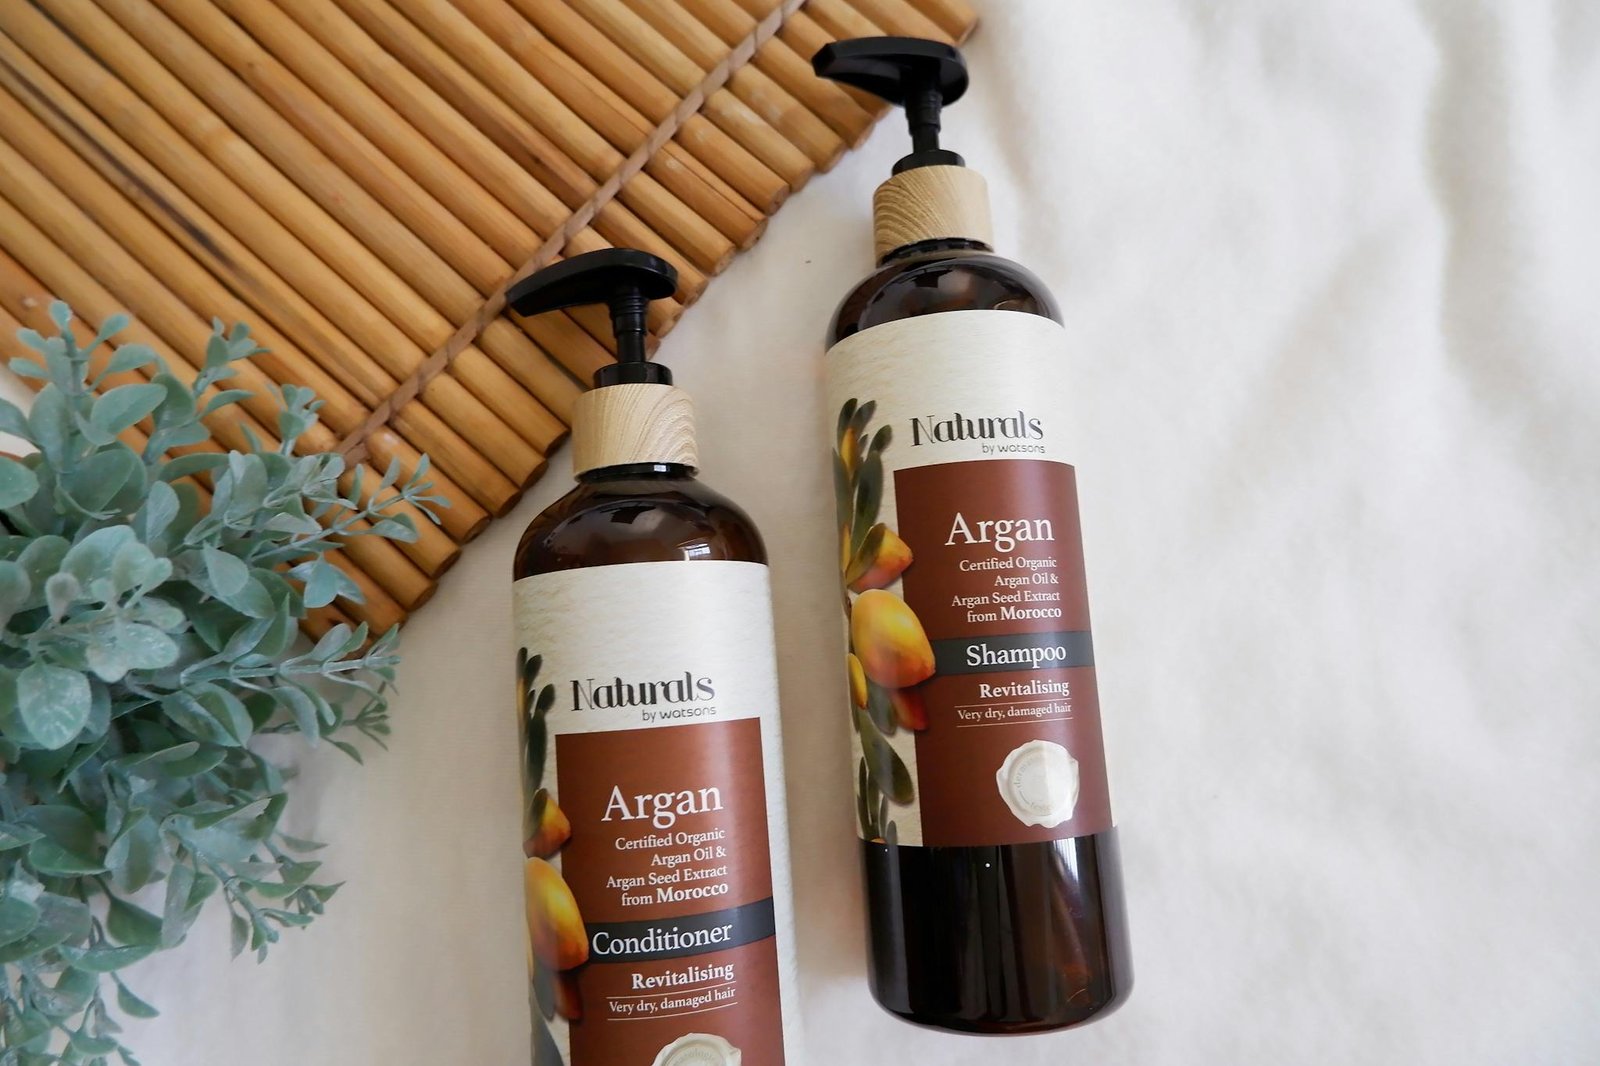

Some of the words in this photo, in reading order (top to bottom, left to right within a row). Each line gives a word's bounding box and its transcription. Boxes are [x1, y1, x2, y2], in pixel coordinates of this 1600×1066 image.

[910, 410, 1044, 446] Naturals
[982, 444, 995, 455] by
[998, 444, 1045, 454] watsons
[944, 512, 1055, 553] Argan
[960, 557, 1013, 571] Certified
[1016, 556, 1056, 570] Organic
[994, 576, 1029, 588] Argan
[1032, 573, 1047, 584] Oil
[1050, 573, 1059, 584] &
[952, 595, 989, 608] Argan
[992, 591, 1021, 603] Seed
[1024, 590, 1060, 602] Extract
[967, 610, 997, 622] from
[1000, 606, 1061, 620] Morocco
[966, 643, 1066, 669] Shampoo
[570, 671, 715, 711] Naturals
[979, 680, 1069, 698] Revitalising
[642, 710, 657, 723] by
[660, 706, 717, 719] watsons
[958, 710, 982, 721] Very
[985, 708, 1005, 720] dry,
[1007, 703, 1052, 717] damaged
[1054, 702, 1071, 713] hair
[601, 785, 724, 829] Argan
[615, 832, 672, 850] Certified
[676, 828, 725, 845] Organic
[651, 852, 691, 868] Argan
[694, 847, 713, 861] Oil
[716, 846, 726, 857] &
[606, 876, 645, 891] Argan
[648, 870, 680, 885] Seed
[684, 866, 728, 881] Extract
[621, 893, 653, 906] from
[657, 883, 728, 903] Morocco
[592, 924, 733, 955] Conditioner
[632, 963, 734, 989] Revitalising
[609, 1001, 634, 1015] Very
[637, 1000, 658, 1014] dry,
[660, 991, 712, 1010] damaged
[714, 987, 736, 1001] hair
